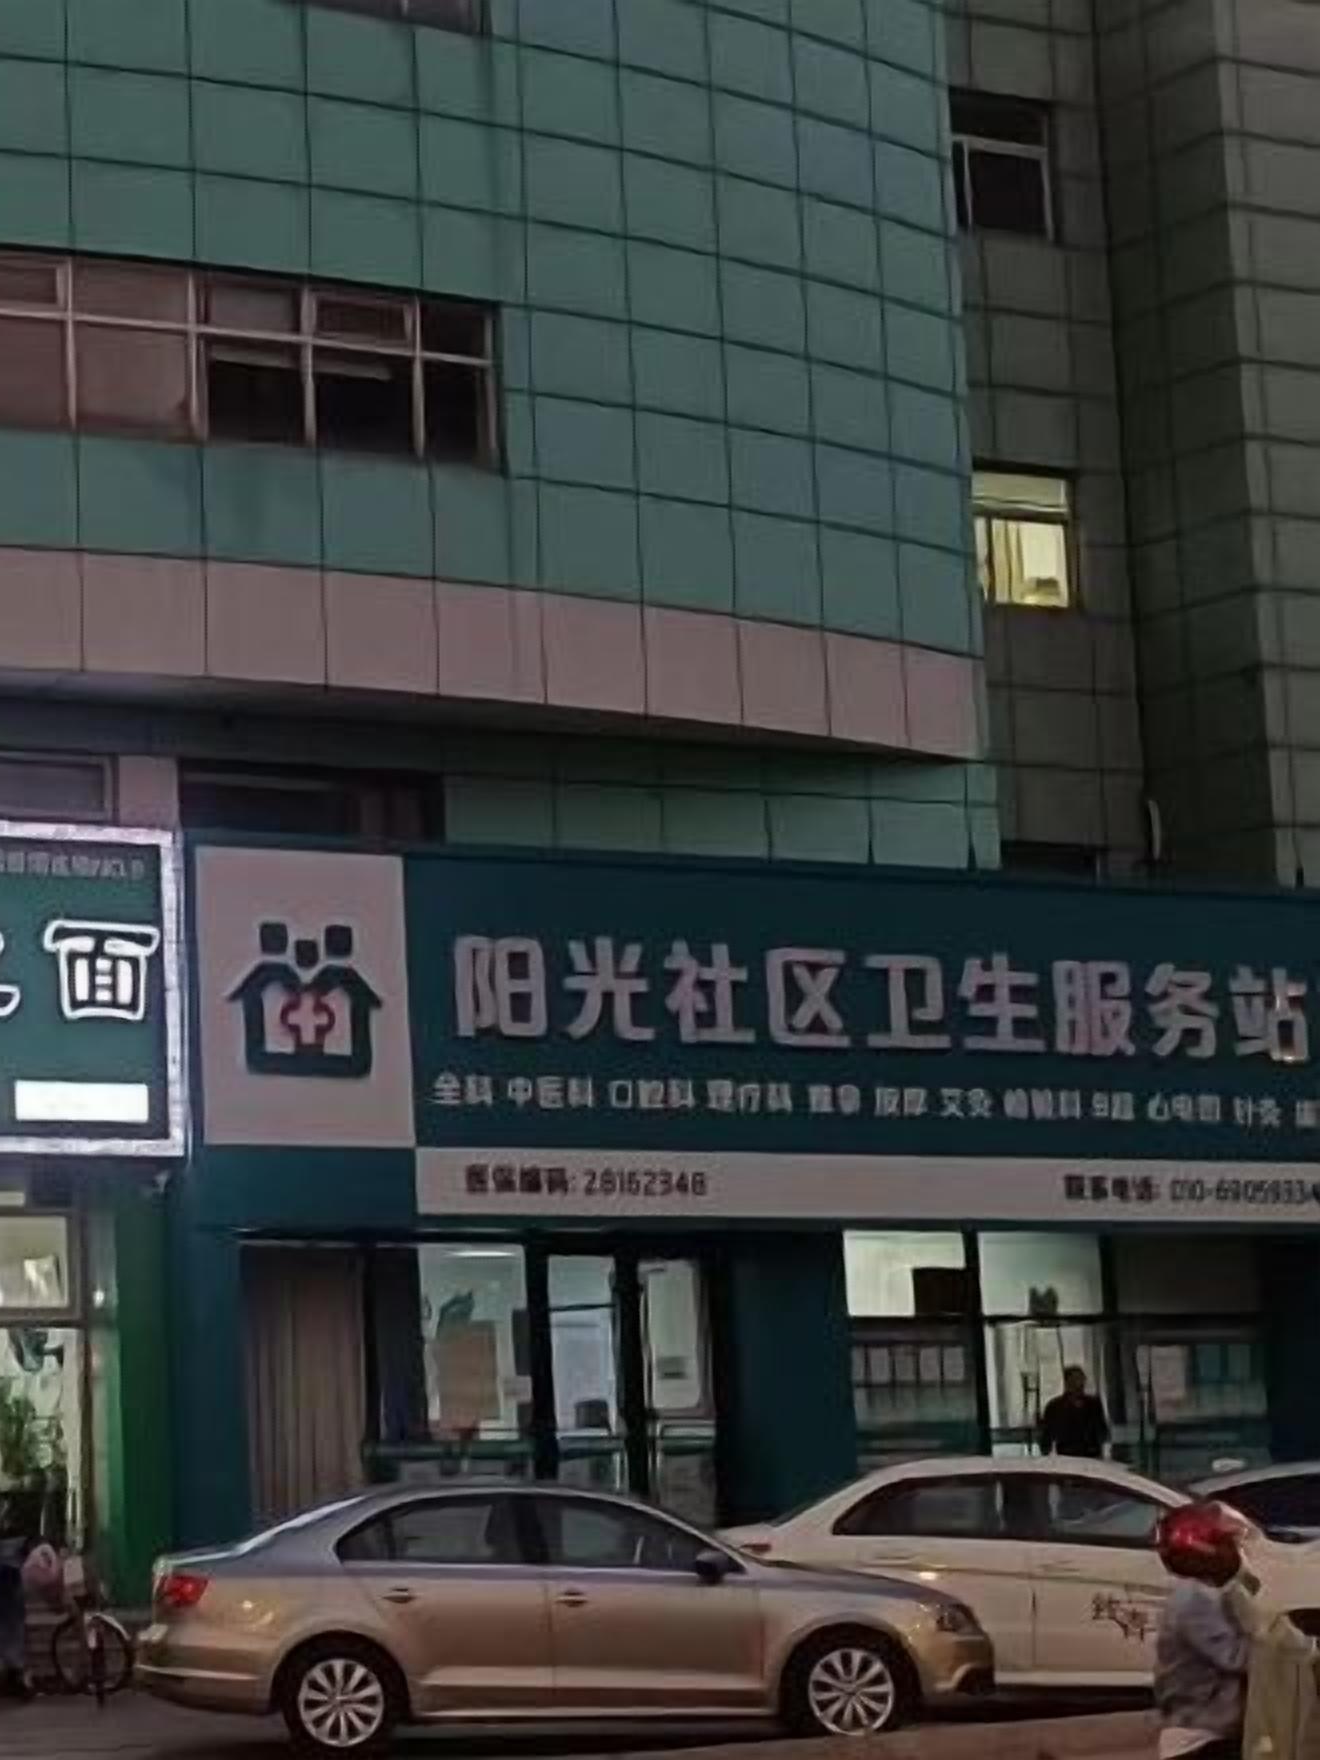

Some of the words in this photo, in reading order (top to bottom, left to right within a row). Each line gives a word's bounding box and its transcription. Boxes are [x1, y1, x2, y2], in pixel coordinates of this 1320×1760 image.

[455, 935, 1309, 1063] 阳光社区卫生服务站
[431, 1071, 493, 1106] 全科
[507, 1076, 593, 1109] 中医科
